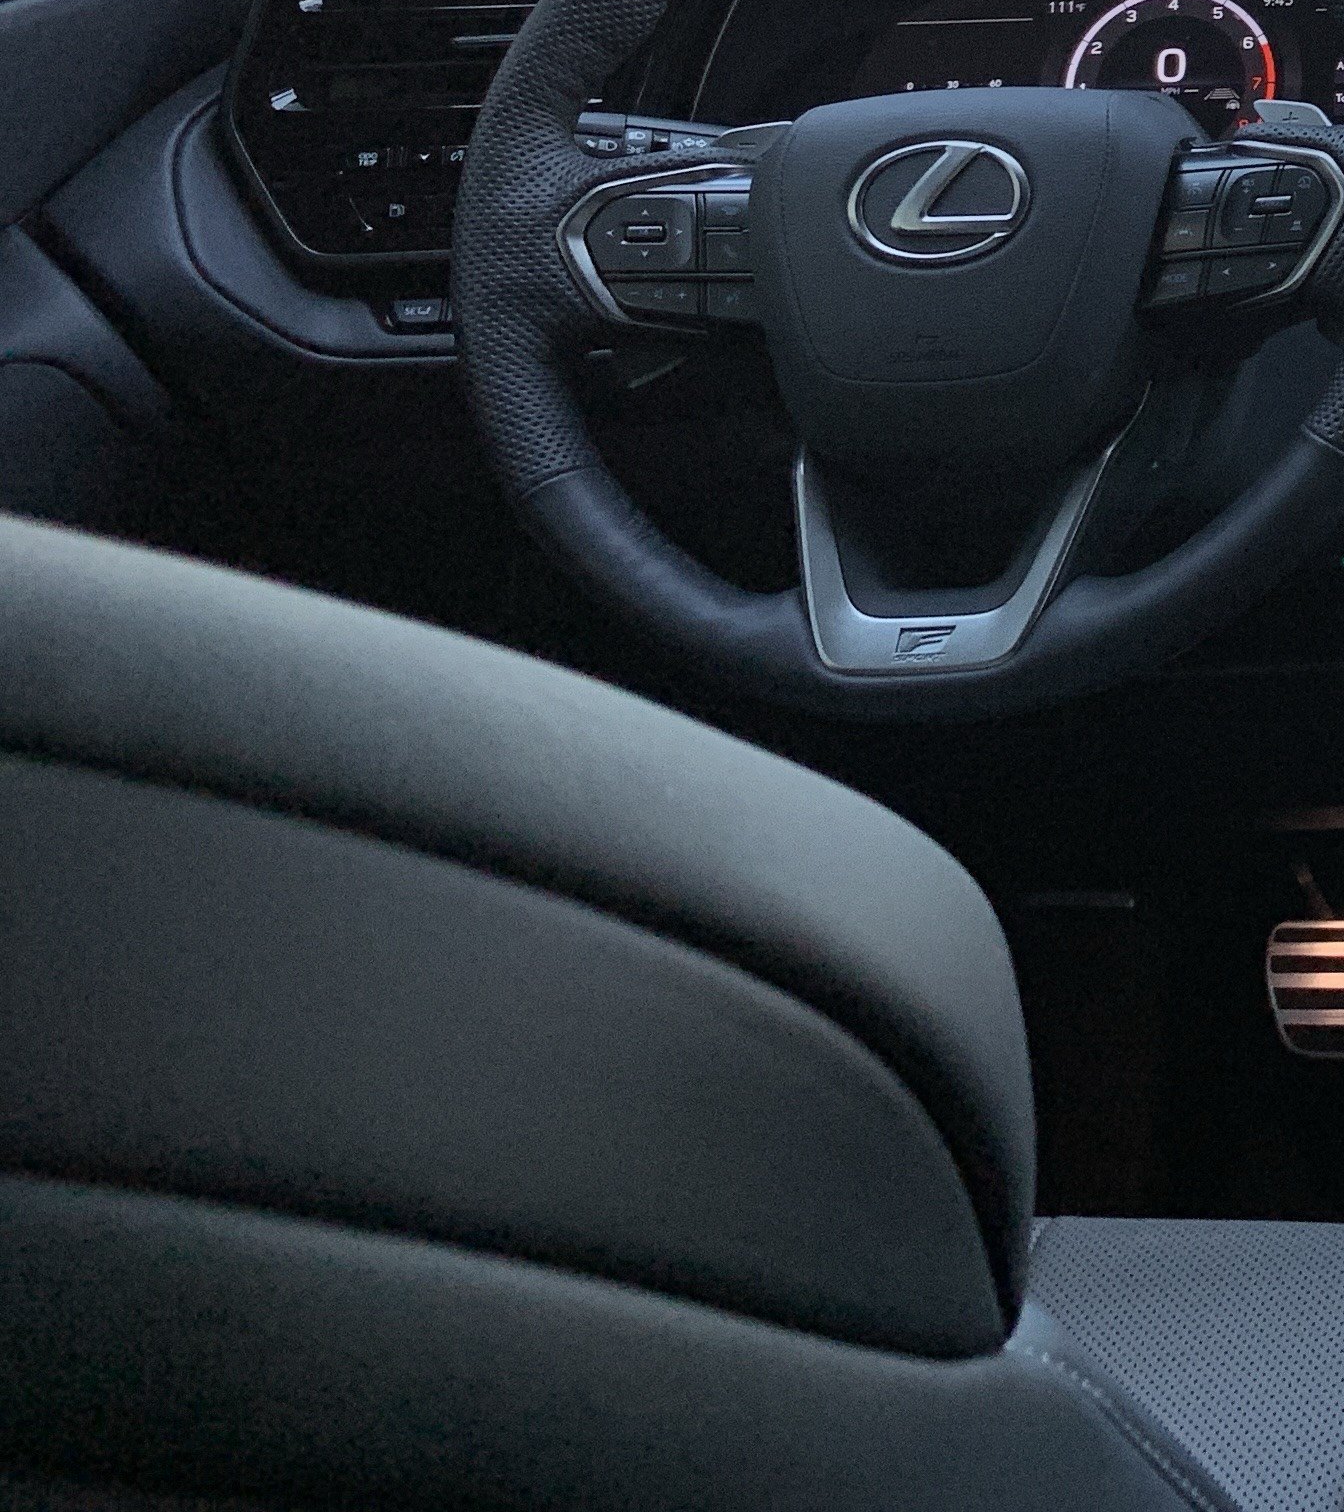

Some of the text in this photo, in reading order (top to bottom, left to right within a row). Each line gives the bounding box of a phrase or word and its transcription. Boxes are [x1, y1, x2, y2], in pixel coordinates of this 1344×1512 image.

[1168, 0, 1179, 10] 4
[1126, 7, 1224, 22] 3 5
[1091, 42, 1102, 54] 2
[1242, 37, 1254, 49] 6
[1156, 48, 1187, 82] 0
[947, 80, 959, 89] 30
[989, 79, 1003, 88] 60
[1252, 76, 1261, 90] 7
